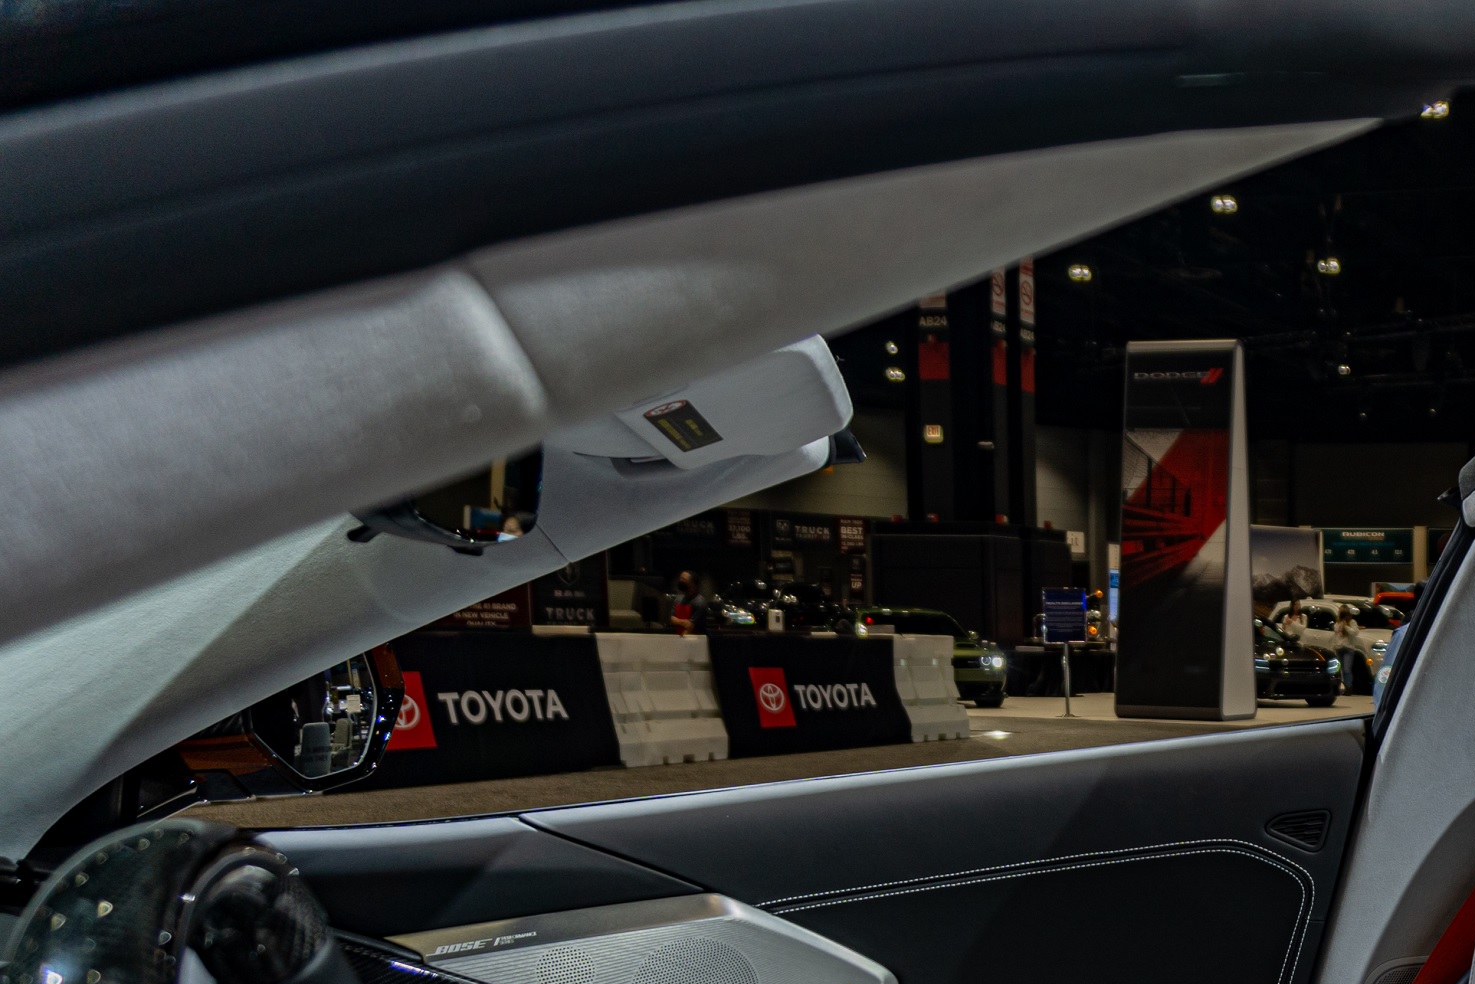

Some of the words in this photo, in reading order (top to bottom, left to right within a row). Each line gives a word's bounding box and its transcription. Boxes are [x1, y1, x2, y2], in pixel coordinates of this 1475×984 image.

[919, 315, 947, 327] AB24
[928, 425, 939, 435] EXIT
[794, 525, 830, 535] TRUCK
[840, 526, 863, 535] BEST
[851, 581, 862, 589] UP
[492, 602, 517, 610] BRAND
[545, 606, 595, 620] TRUCK
[793, 682, 877, 710] TOYOTA
[437, 688, 570, 725] TOYOTA
[426, 938, 493, 957] BOSE
